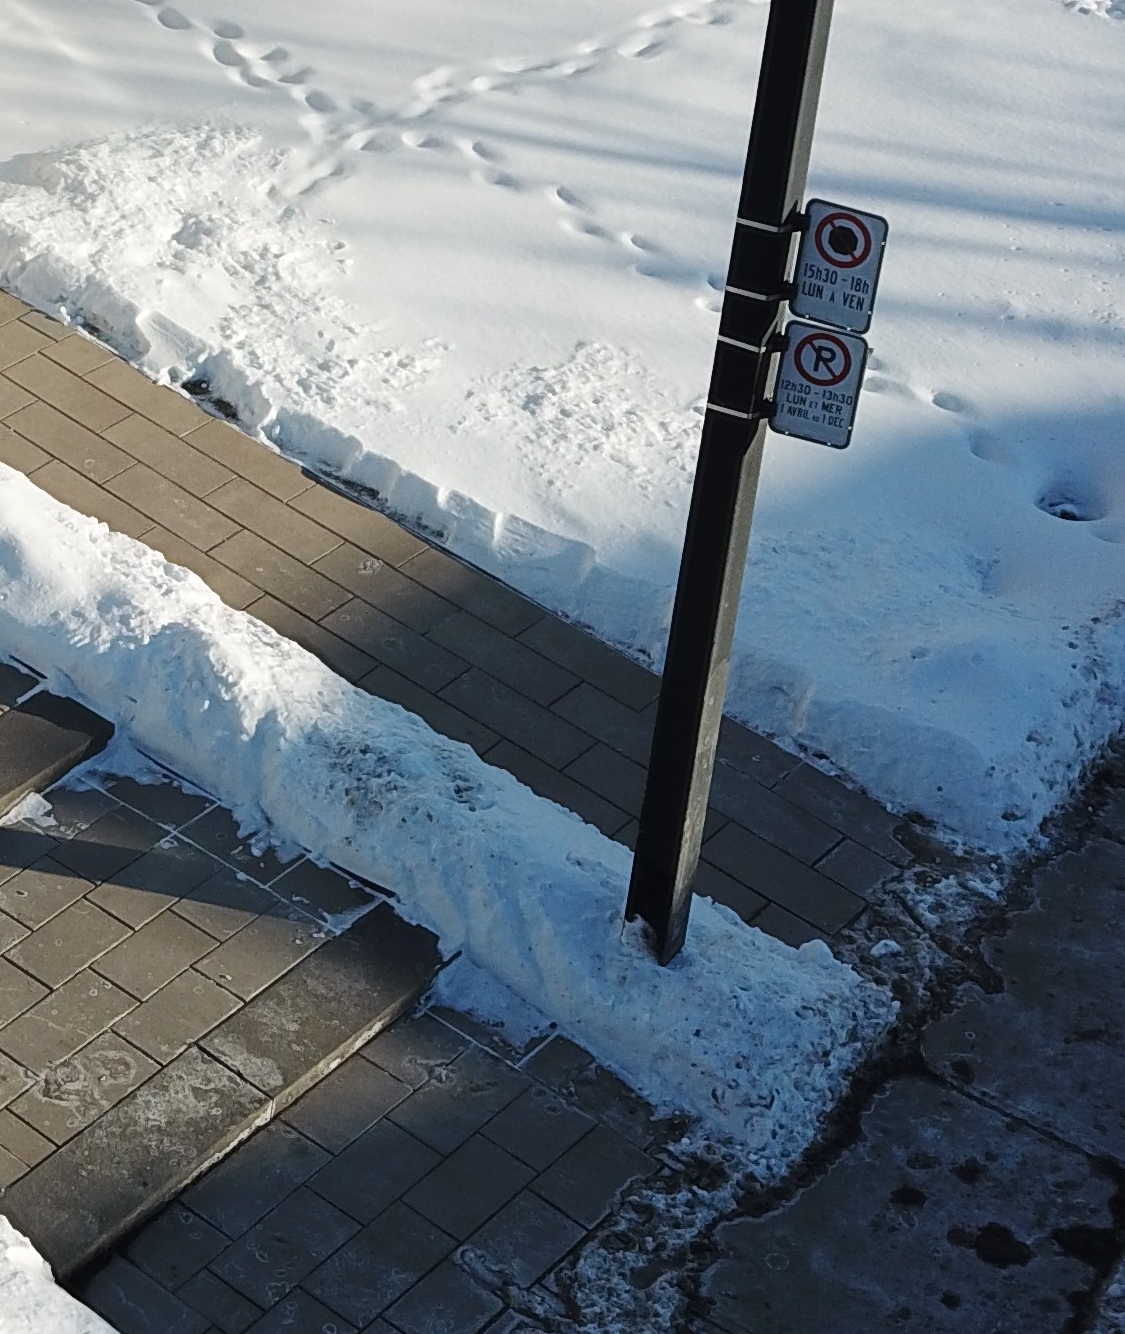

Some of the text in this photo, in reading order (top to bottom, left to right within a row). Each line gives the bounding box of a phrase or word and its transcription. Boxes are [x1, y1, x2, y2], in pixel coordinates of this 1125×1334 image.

[804, 263, 838, 285] 15h30
[850, 276, 869, 294] 18h
[802, 281, 824, 300] LUN
[843, 292, 865, 312] VEN
[780, 379, 811, 395] 12h30
[822, 389, 853, 406] 13h30
[786, 392, 807, 407] LUN
[821, 401, 843, 415] MER
[786, 405, 809, 420] AVRIL
